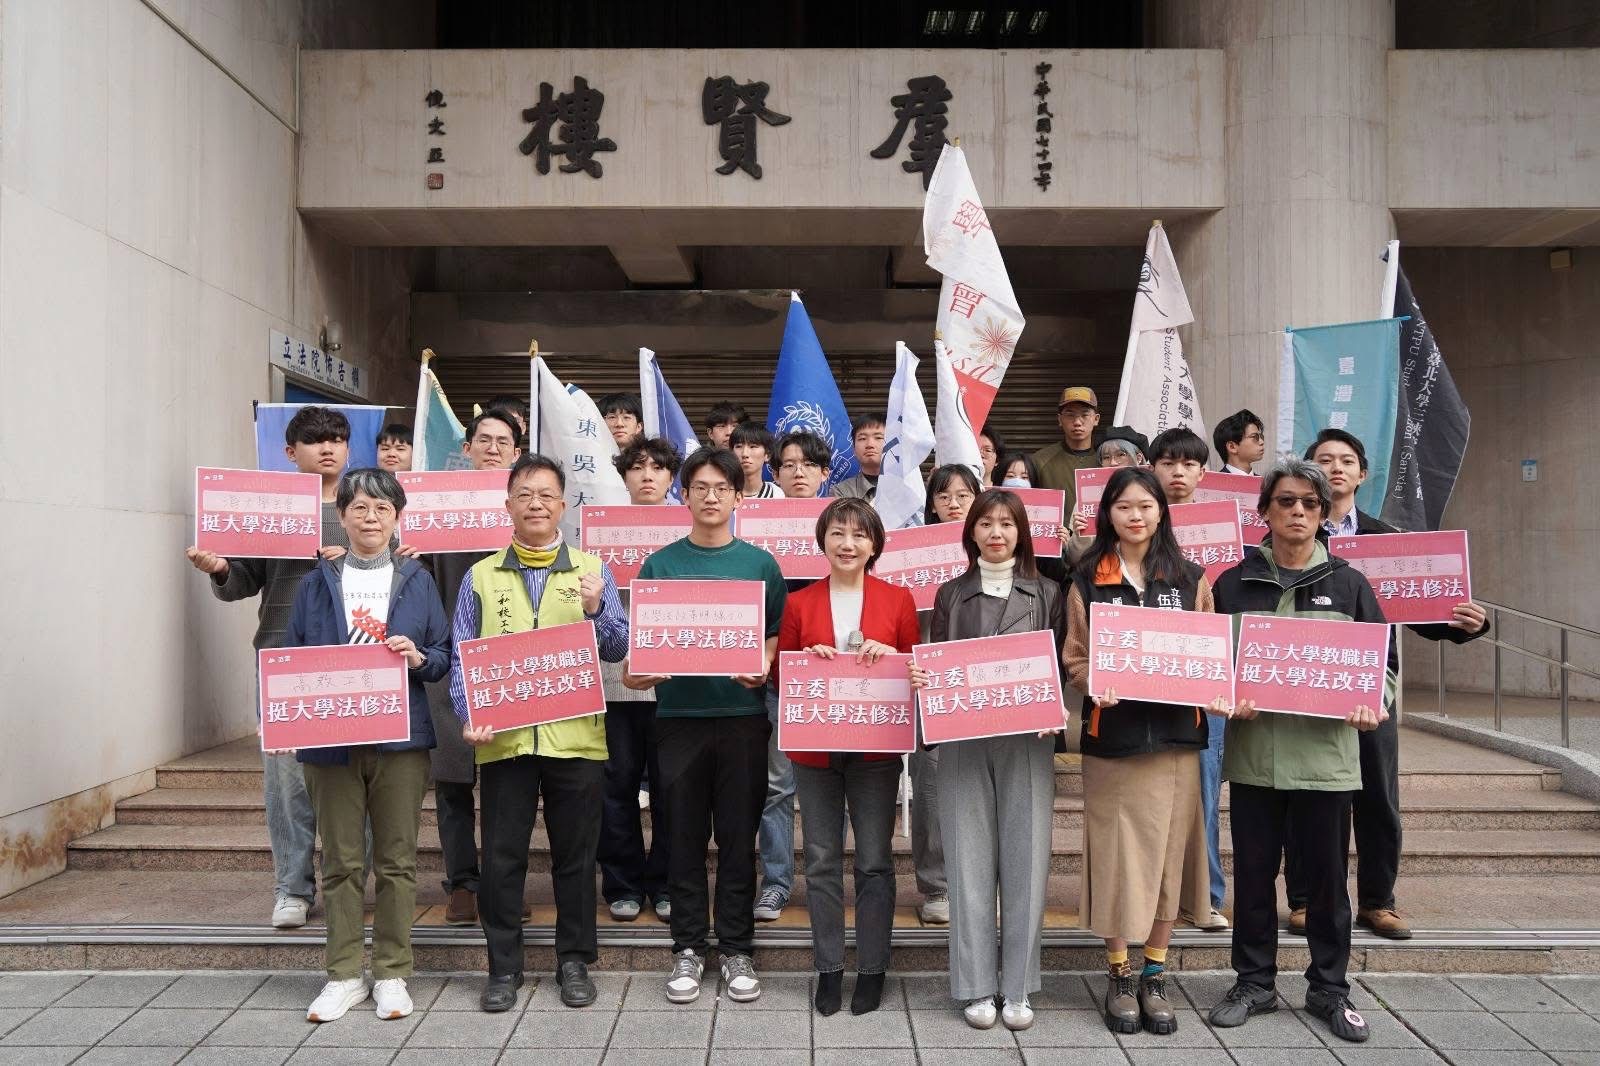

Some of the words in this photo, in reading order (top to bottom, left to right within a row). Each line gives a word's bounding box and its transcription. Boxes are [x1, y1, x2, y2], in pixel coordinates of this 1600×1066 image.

[201, 513, 318, 536] 挺大學法修法
[635, 629, 758, 650] 挺大學法修法
[1096, 627, 1139, 650] 立委
[469, 647, 594, 686] 私立大學教職員
[1095, 651, 1228, 682] 挺大學法修法
[1244, 641, 1380, 669] 公立大學教職員
[472, 669, 597, 710] 挺大學法改革
[785, 678, 826, 699] 立委
[924, 666, 965, 691] 立委
[1240, 663, 1378, 693] 挺大學法改革
[267, 694, 403, 724] 挺大學法修法
[926, 682, 1057, 717] 挺大學法修法
[784, 703, 910, 725] 挺大學法修法
